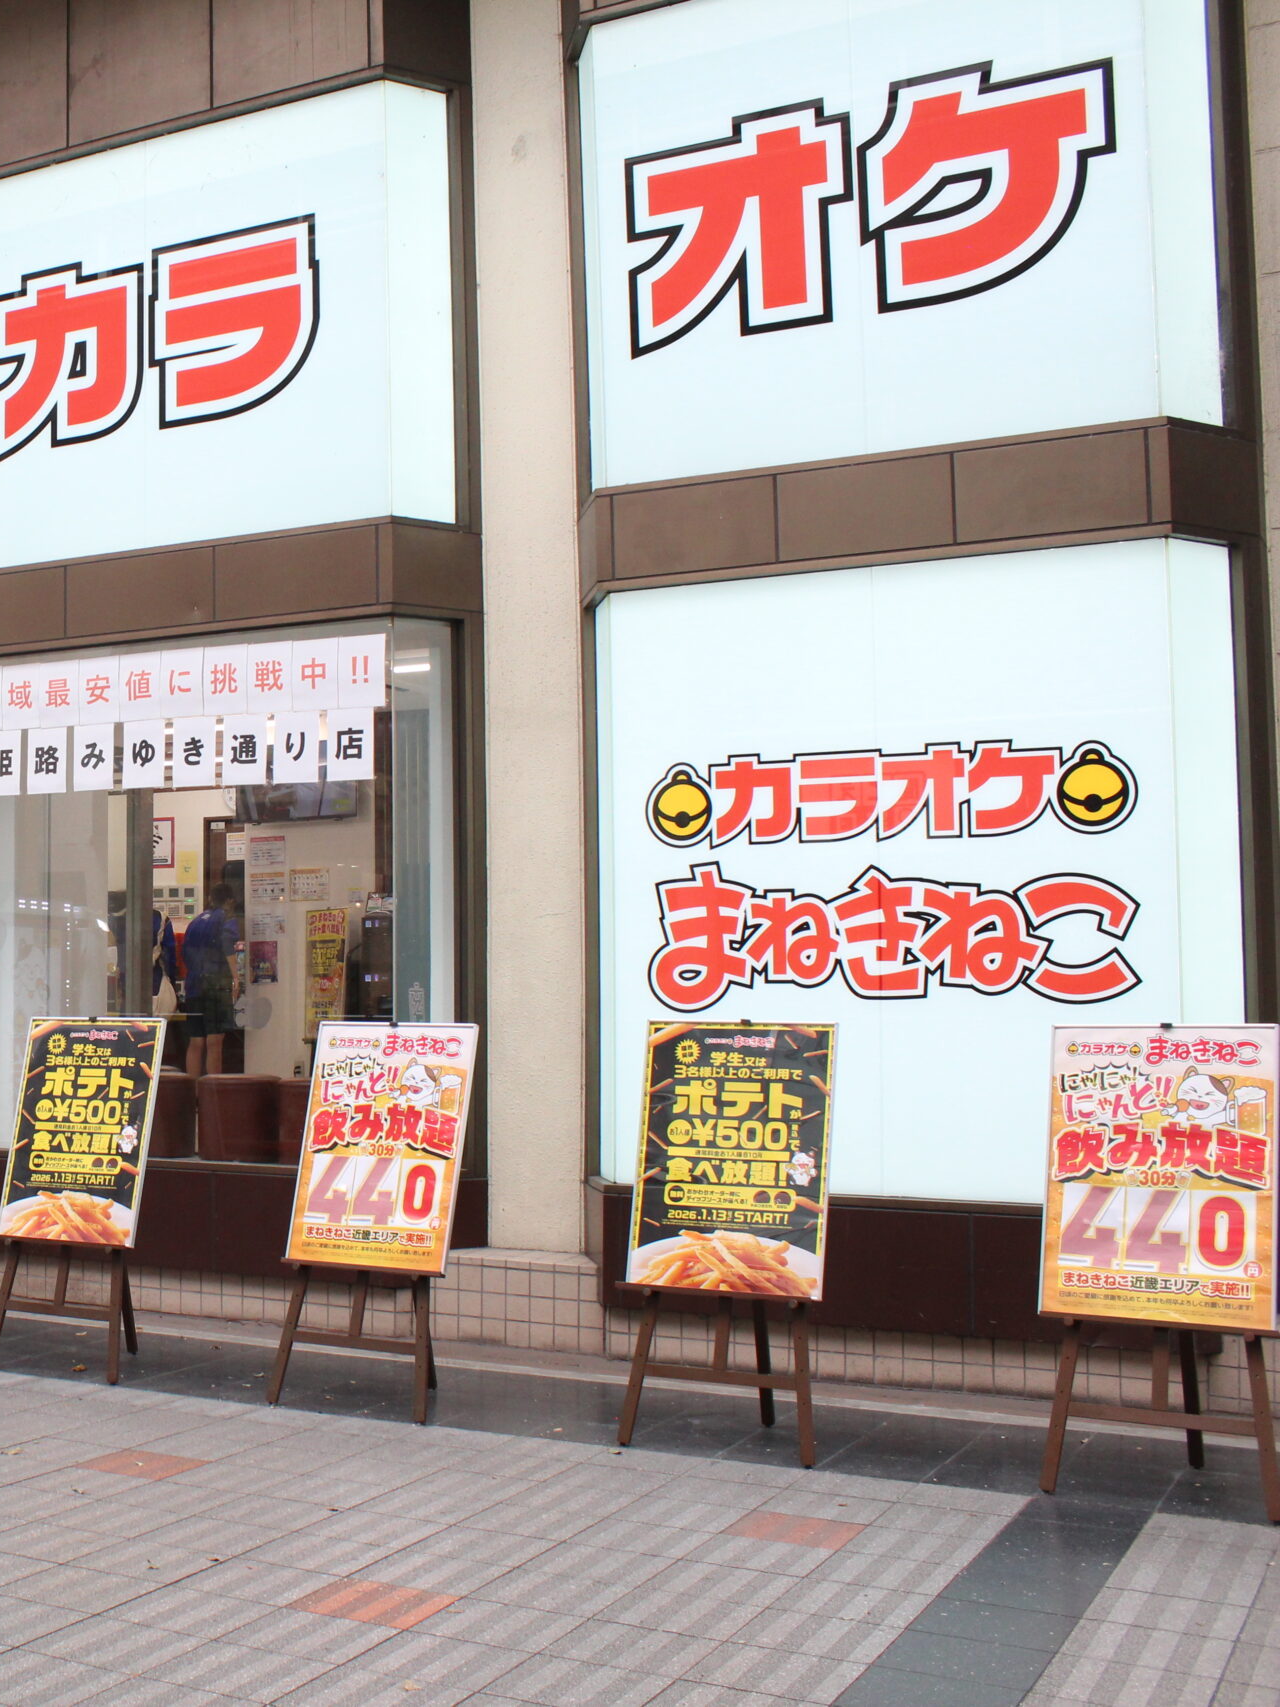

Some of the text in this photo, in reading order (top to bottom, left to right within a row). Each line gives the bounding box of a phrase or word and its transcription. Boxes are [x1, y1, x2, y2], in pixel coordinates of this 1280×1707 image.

[624, 56, 1117, 360] オケ
[709, 739, 1062, 849] カラオケ
[648, 862, 1142, 1013] まねきねこ
[72, 1043, 111, 1056] 学生又は
[338, 1033, 463, 1057] カラオケ まねきねこ
[1080, 1034, 1262, 1066] カラオケ まねきねこ
[46, 1055, 136, 1067] 3名様以上のご利用で
[710, 1051, 767, 1067] 学生又は
[674, 1064, 803, 1080] 3名様以上のご利用で
[54, 1098, 122, 1125] ¥500
[310, 1104, 459, 1156] 飲み放題
[692, 1118, 787, 1150] ¥500
[368, 1143, 395, 1156] 30分
[1055, 1121, 1268, 1186] 飲み放題
[76, 1174, 115, 1187] START!
[1138, 1170, 1176, 1187] 30分
[668, 1209, 728, 1221] 2026.1.13
[734, 1211, 789, 1225] START!
